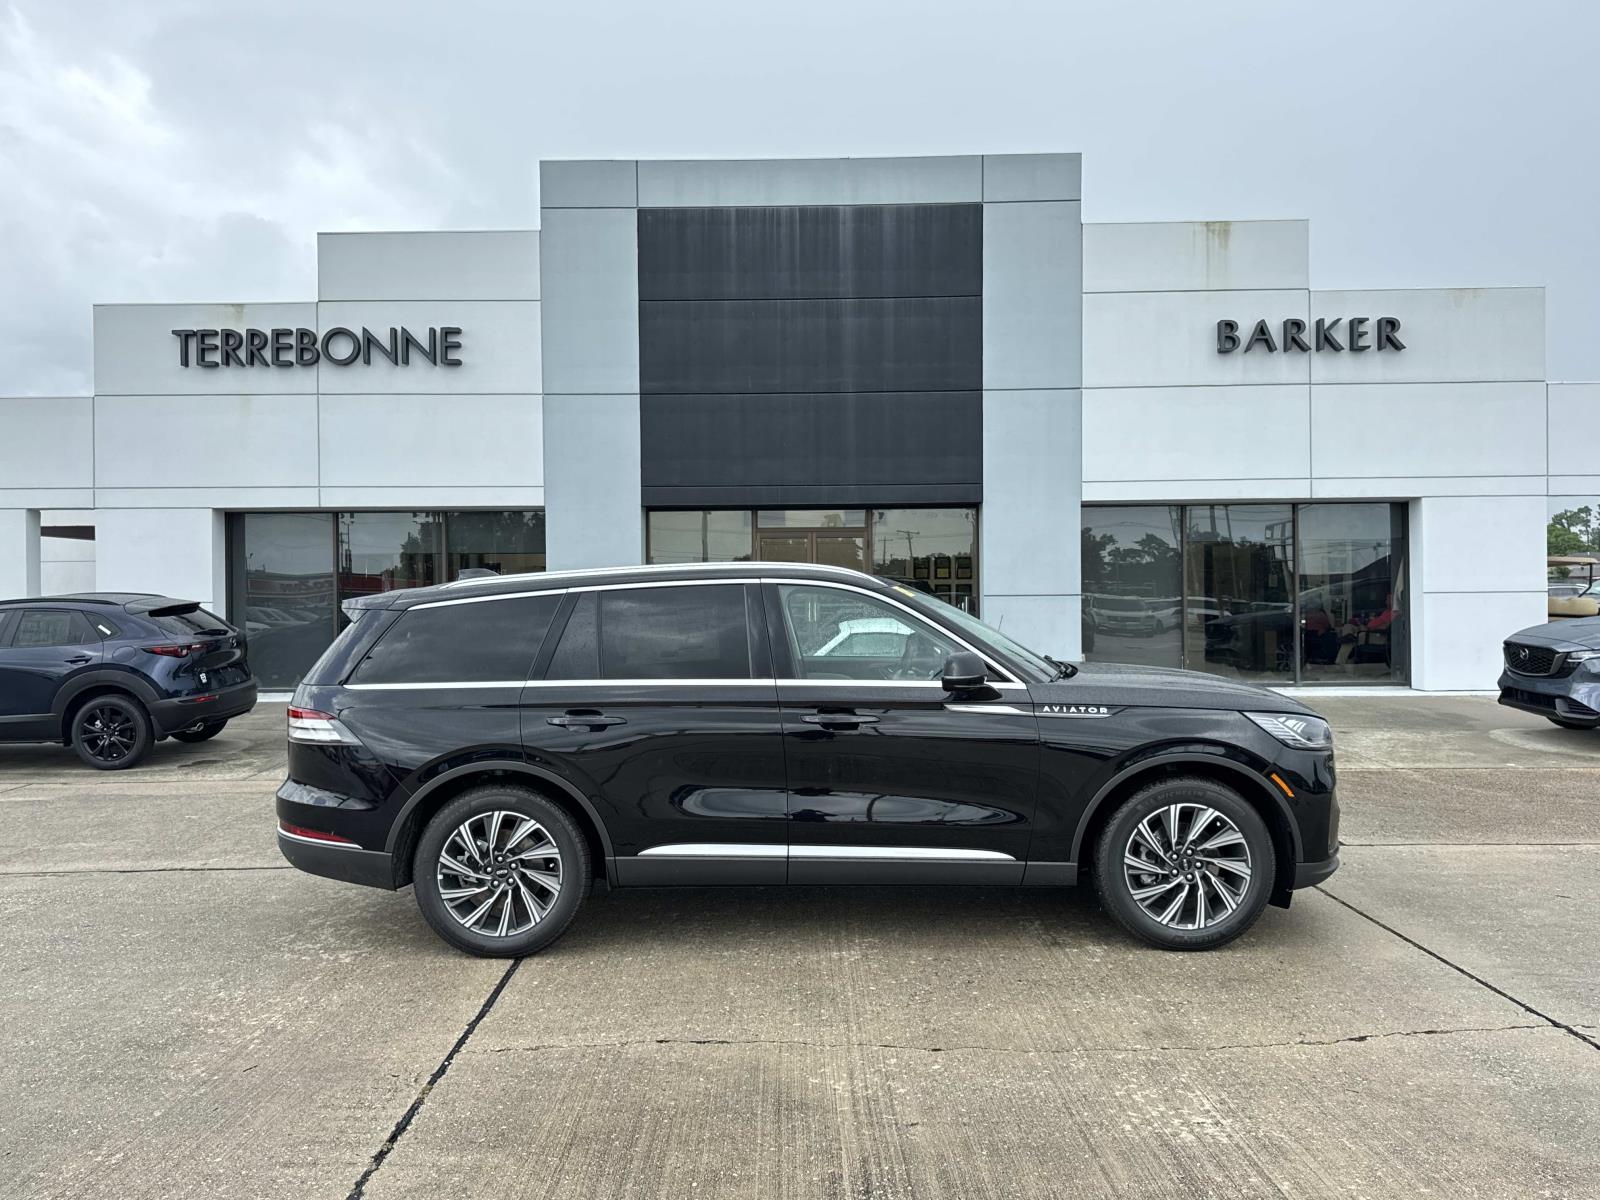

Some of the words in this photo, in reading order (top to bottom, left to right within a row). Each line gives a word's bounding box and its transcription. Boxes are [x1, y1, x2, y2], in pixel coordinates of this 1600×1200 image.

[172, 326, 463, 367] TERREBONNE
[1217, 317, 1406, 353] BARKER
[1043, 705, 1108, 714] AVIATOR
